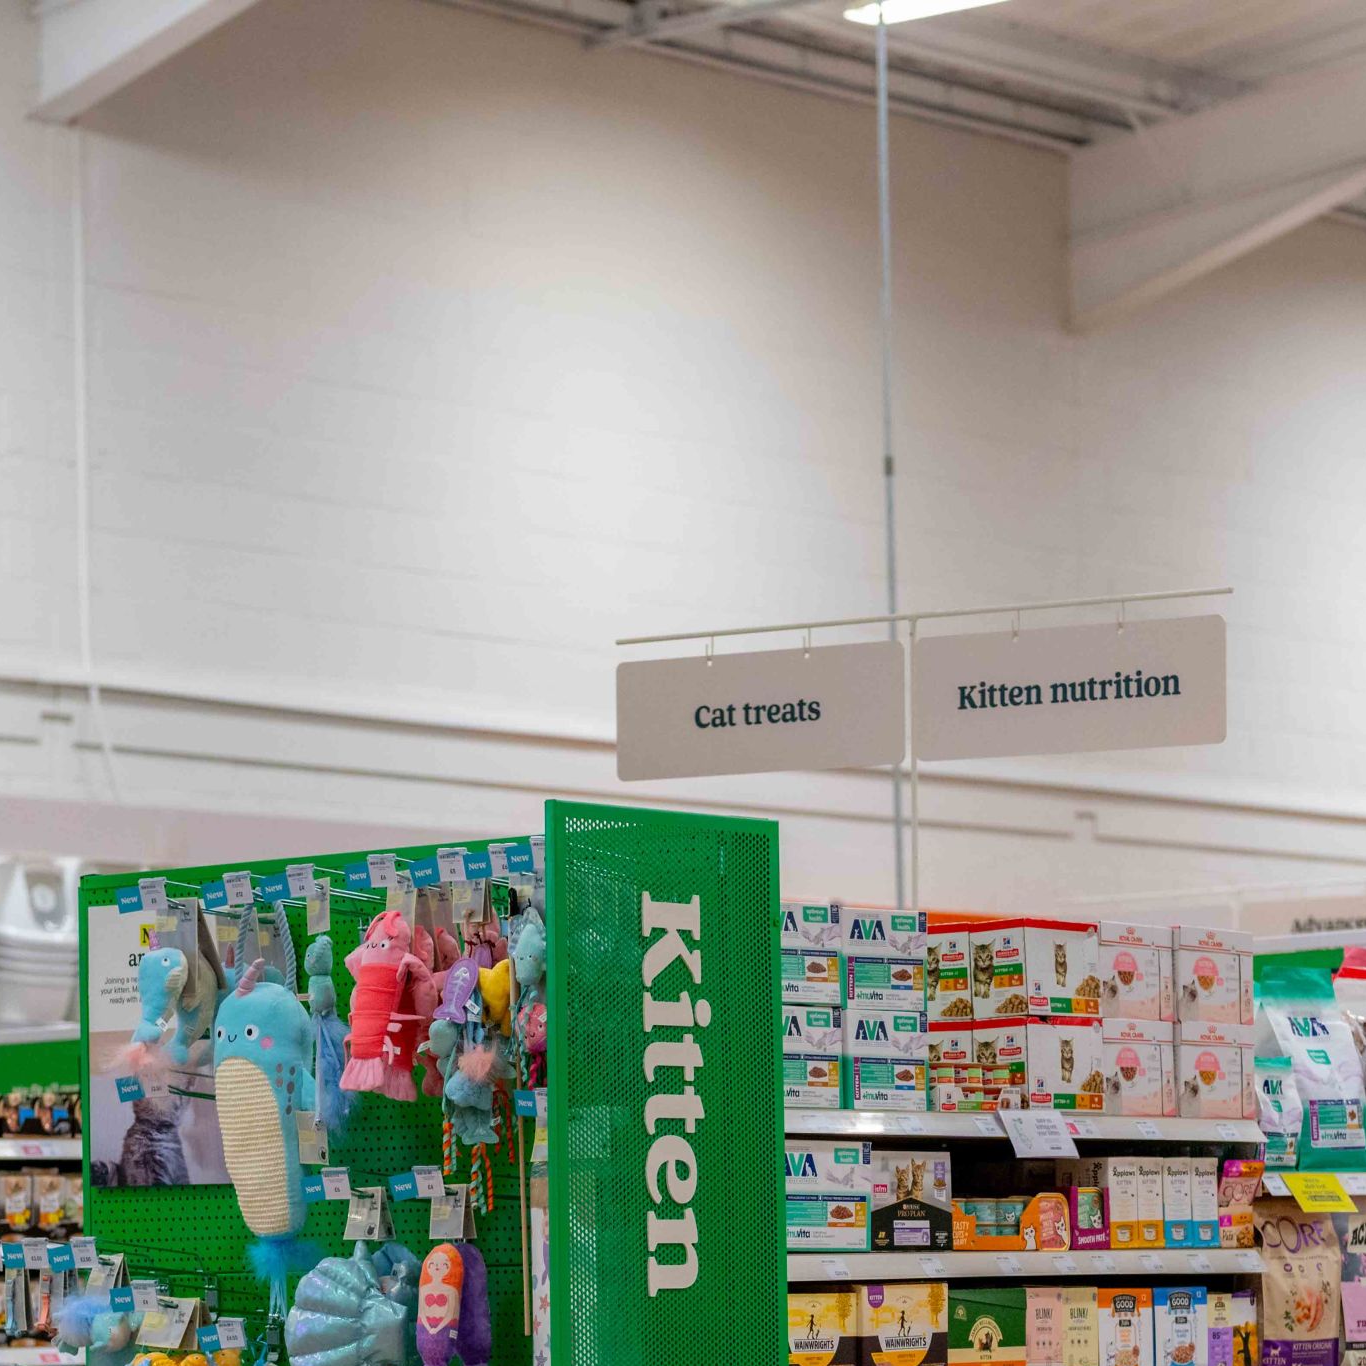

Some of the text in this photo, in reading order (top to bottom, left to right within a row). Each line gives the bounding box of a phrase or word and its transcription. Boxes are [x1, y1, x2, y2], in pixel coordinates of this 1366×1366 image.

[957, 670, 1181, 711] Kitten nutrition
[693, 697, 822, 730] Cat treats
[511, 854, 530, 864] New
[468, 862, 487, 871] New
[349, 872, 368, 882] New
[414, 868, 433, 879] New
[265, 883, 283, 893] New
[120, 895, 138, 905] New
[205, 890, 224, 900] New
[849, 918, 886, 941] AVA
[104, 976, 124, 986] Joining
[100, 988, 117, 996] your
[854, 1019, 889, 1041] AVA
[121, 1083, 139, 1093] New
[641, 890, 713, 1298] Kitten
[517, 1099, 534, 1108] New
[1112, 1167, 1136, 1177] Applaws
[1139, 1167, 1160, 1177] Applaws
[1167, 1167, 1189, 1177] Applaws
[1194, 1167, 1216, 1177] Applaws
[305, 1183, 323, 1193] New
[394, 1182, 413, 1192] New
[1261, 1216, 1326, 1254] CORE
[1077, 1236, 1095, 1245] SMOOTH
[6, 1251, 24, 1261] New
[53, 1253, 71, 1263] New
[114, 1295, 132, 1305] New
[1115, 1300, 1134, 1309] GOOD
[1171, 1297, 1190, 1306] GOOD
[201, 1333, 220, 1344] New
